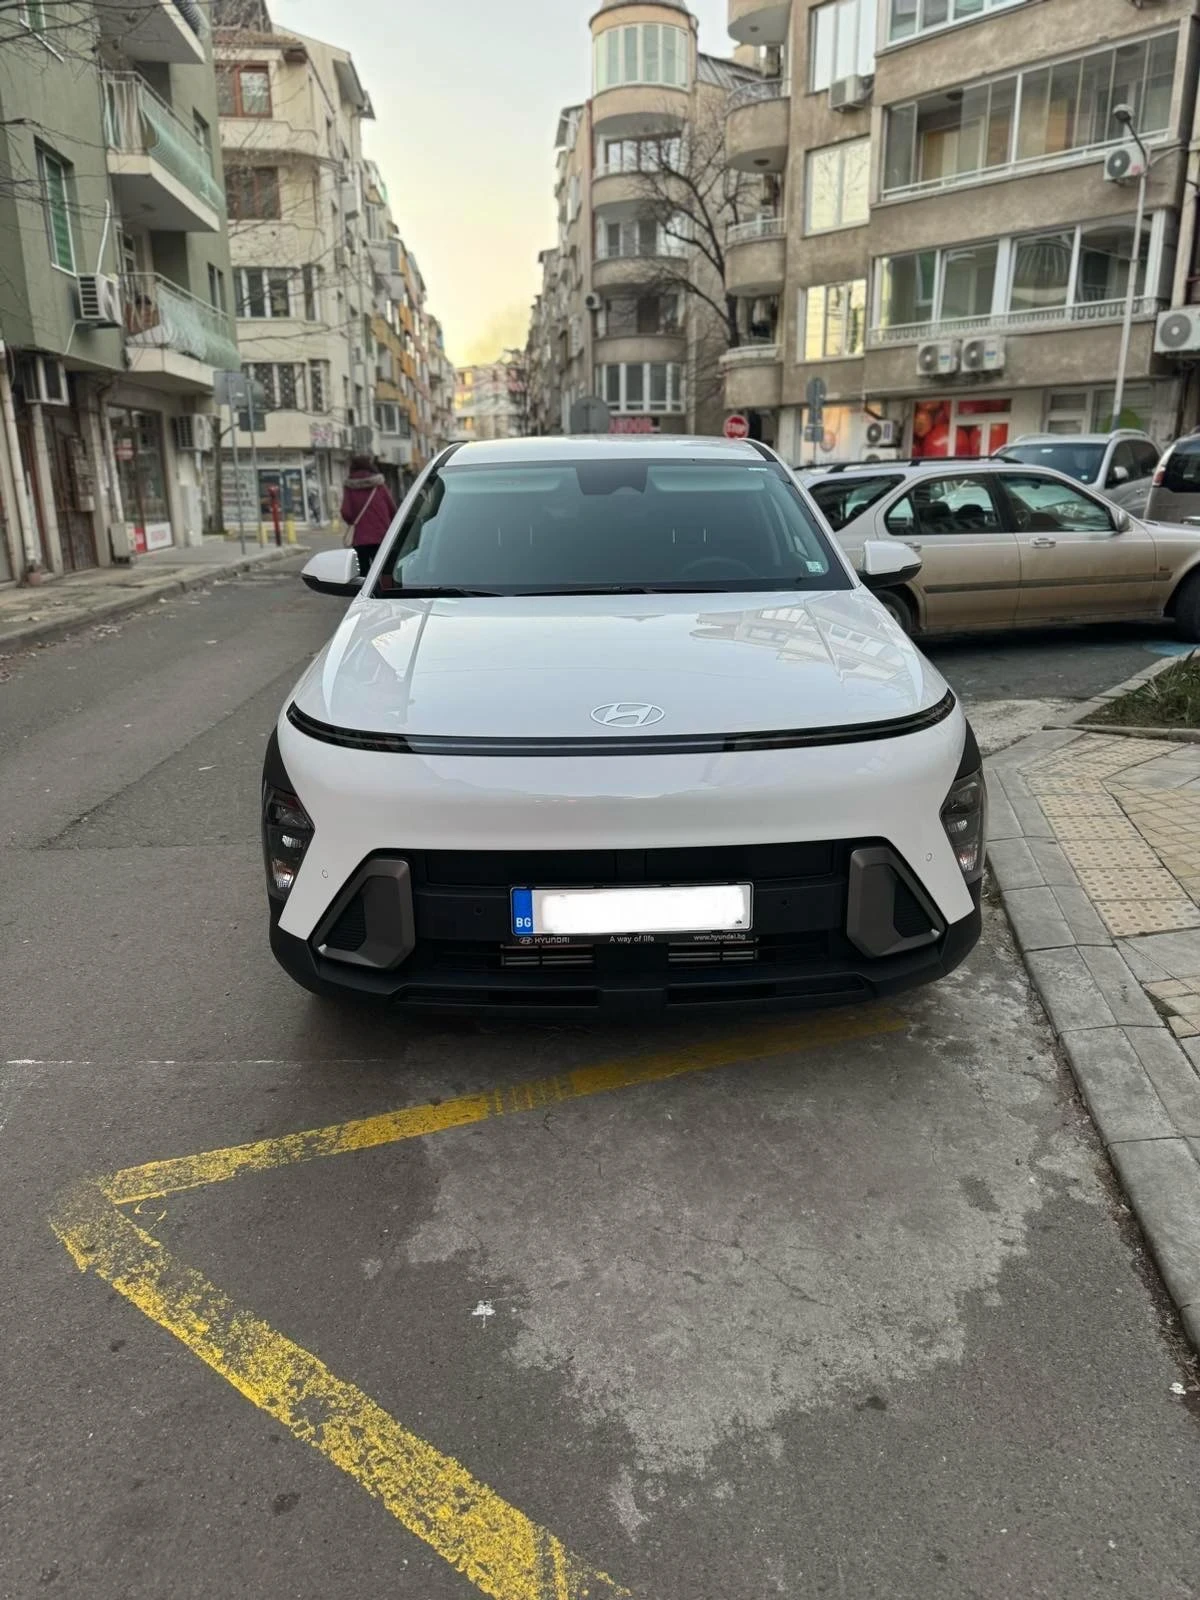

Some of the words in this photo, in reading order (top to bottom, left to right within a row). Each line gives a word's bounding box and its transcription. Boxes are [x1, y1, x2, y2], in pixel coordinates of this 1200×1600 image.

[516, 917, 532, 928] BG
[534, 936, 570, 944] HYUNDAI
[634, 935, 642, 943] of
[643, 935, 655, 943] life
